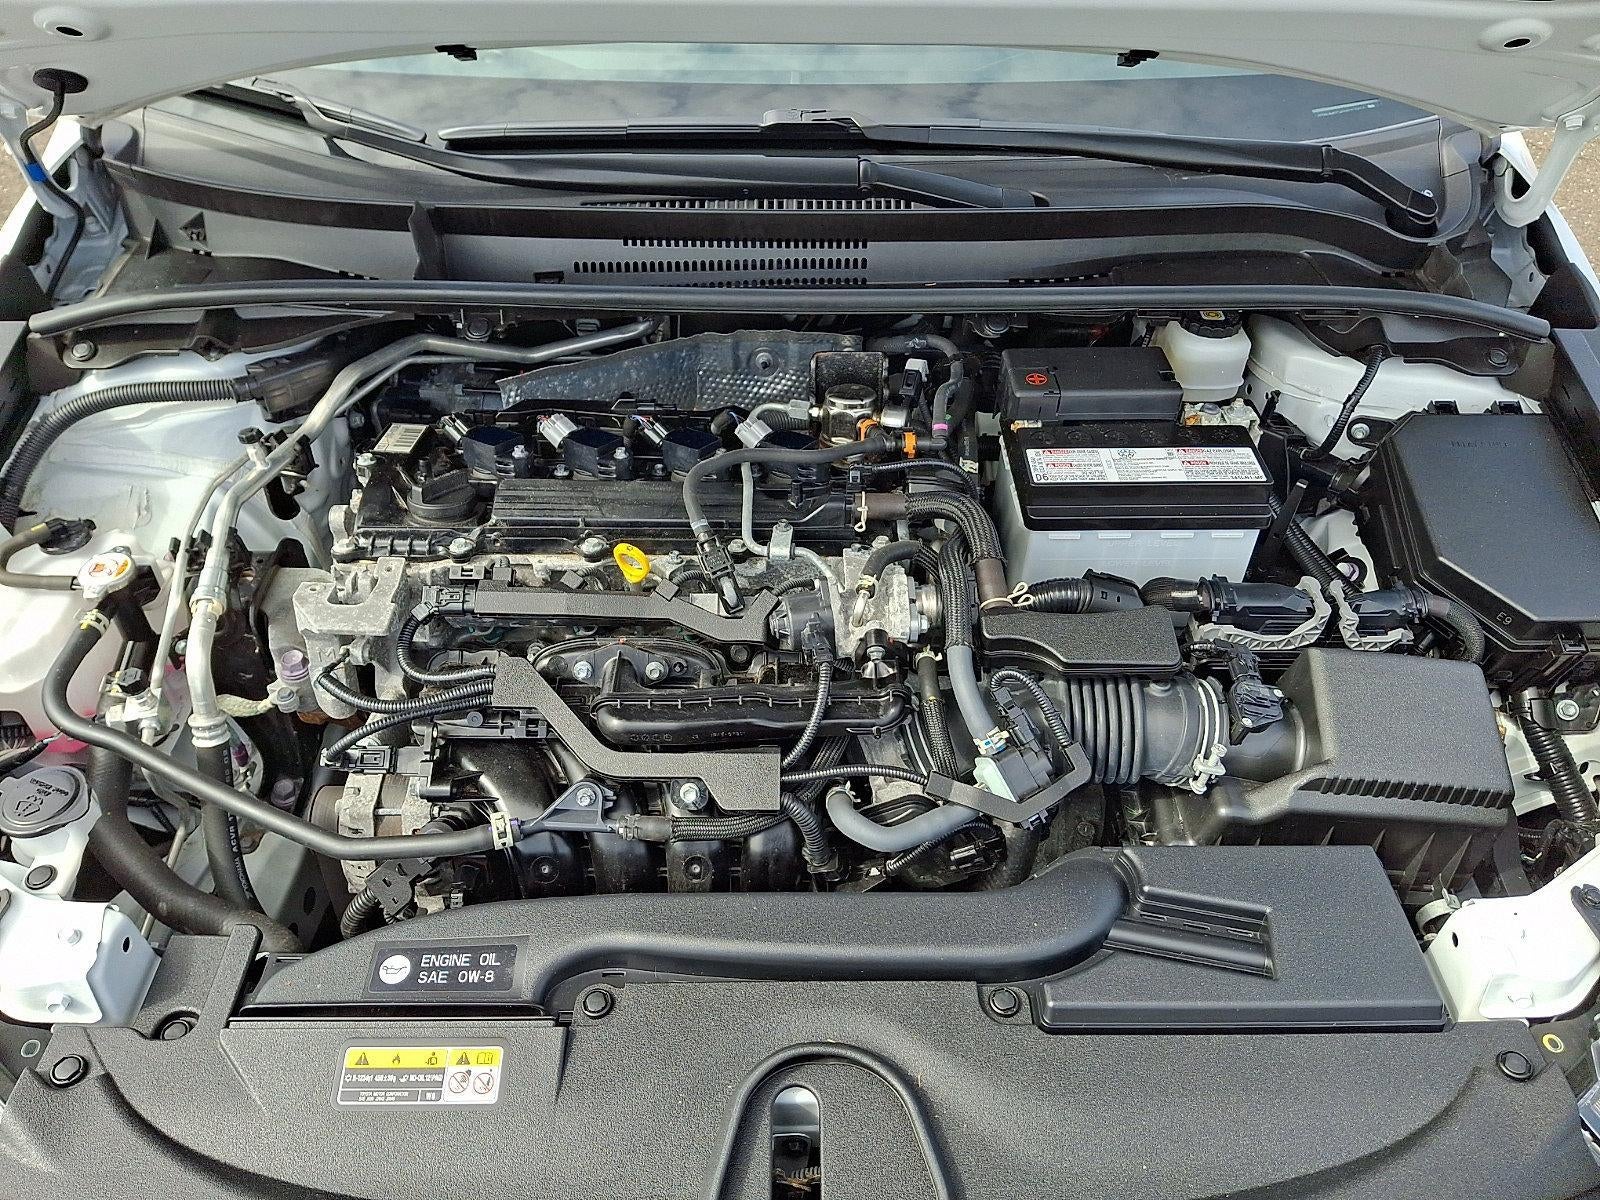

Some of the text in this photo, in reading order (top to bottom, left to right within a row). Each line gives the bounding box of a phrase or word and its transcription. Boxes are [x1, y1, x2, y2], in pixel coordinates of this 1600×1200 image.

[1035, 473, 1049, 481] D6
[1496, 611, 1513, 625] E9
[420, 953, 501, 967] ENGINE OIL
[418, 970, 495, 984] SAE 0W-8
